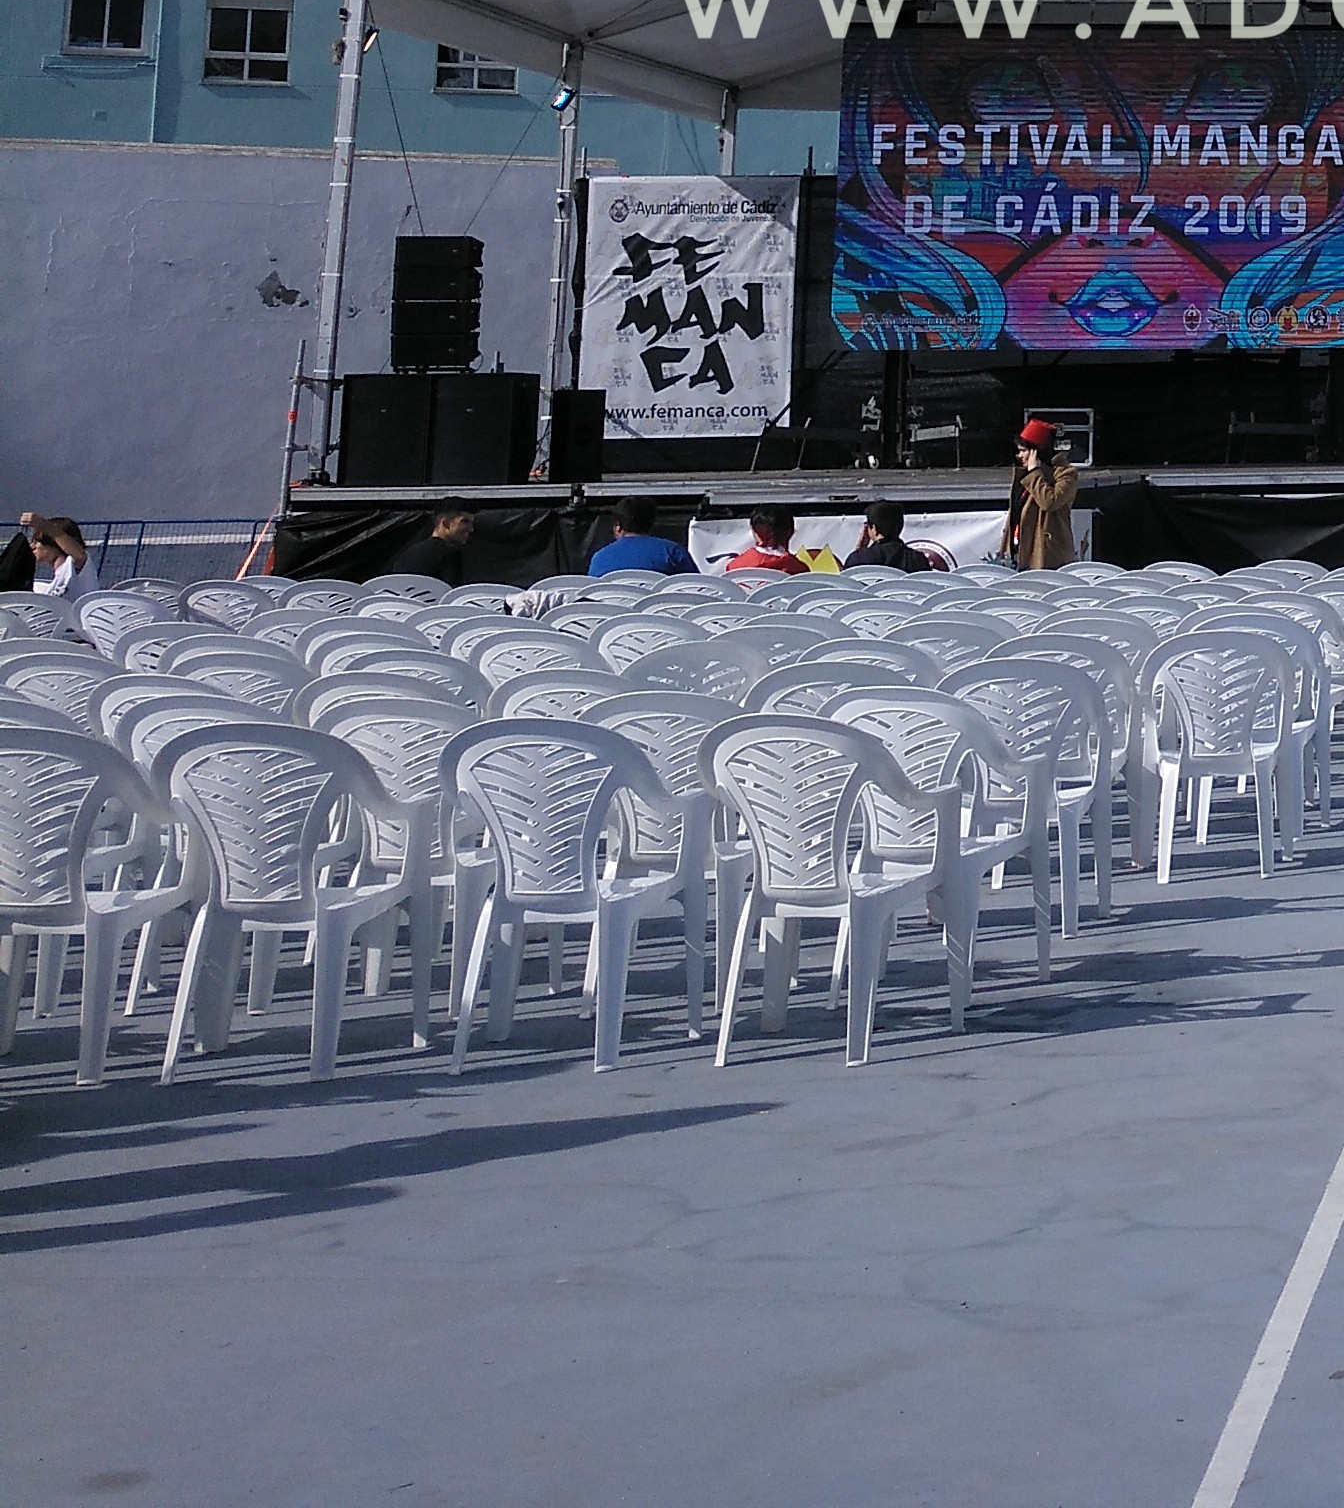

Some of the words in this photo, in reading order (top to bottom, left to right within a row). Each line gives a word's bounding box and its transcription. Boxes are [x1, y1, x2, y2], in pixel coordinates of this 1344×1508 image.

[872, 124, 1127, 165] FESTIVAL
[1150, 124, 1344, 166] MANGA
[635, 201, 719, 218] Ayuntamiento
[722, 201, 738, 214] de
[740, 199, 778, 214] Cádiz
[904, 194, 965, 235] DE
[994, 182, 1156, 235] CÁDIZ
[1182, 195, 1308, 236] 2019
[615, 282, 765, 346] MAN
[605, 403, 768, 420] www.femanca.com
